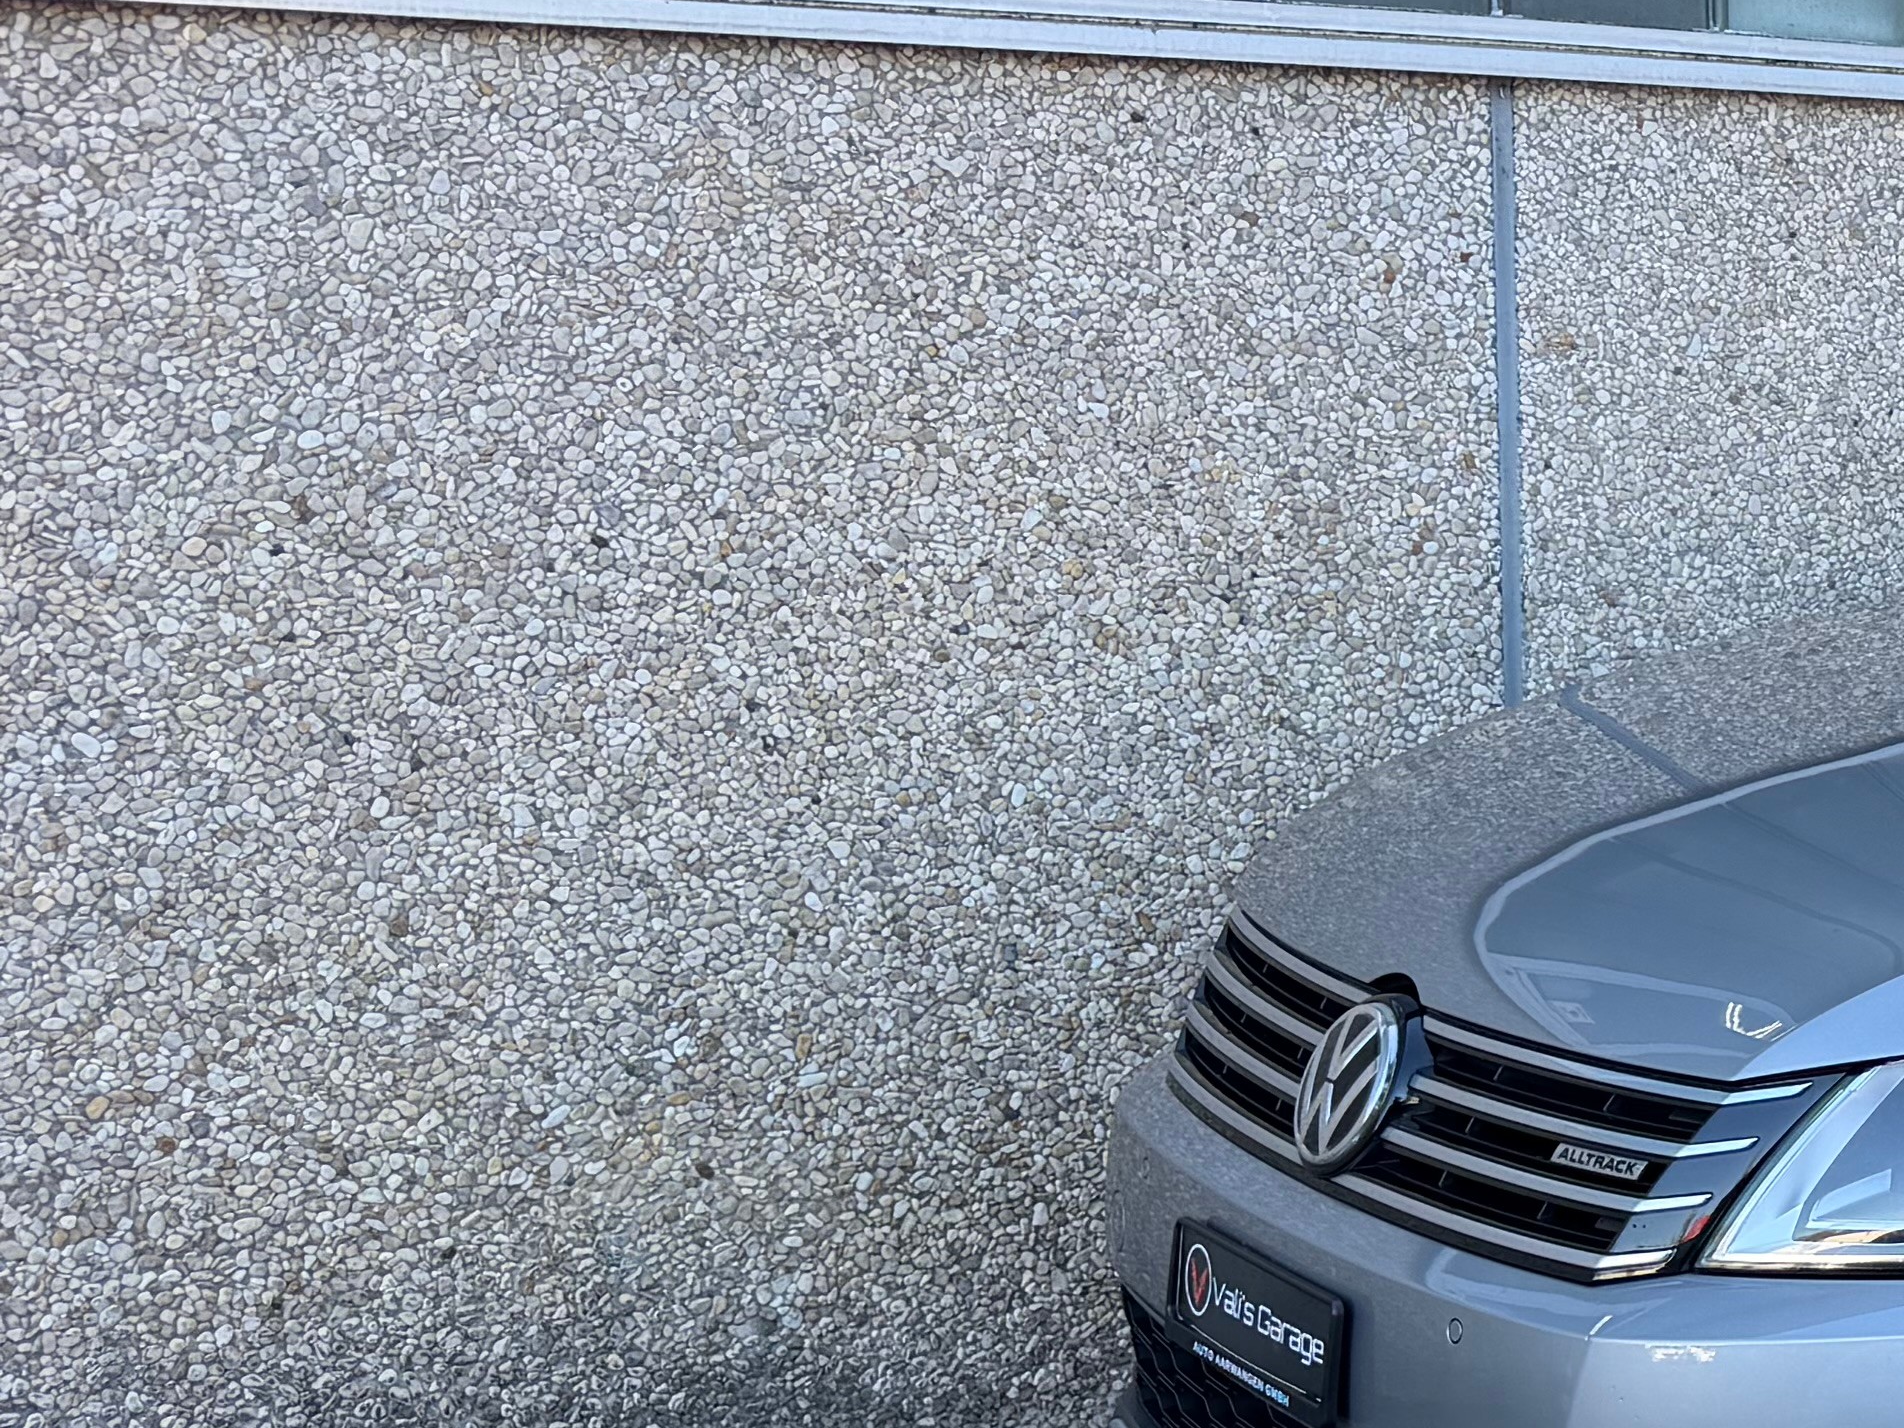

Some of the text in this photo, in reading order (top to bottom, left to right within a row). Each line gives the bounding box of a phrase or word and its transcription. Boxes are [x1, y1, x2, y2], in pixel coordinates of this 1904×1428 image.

[1557, 1147, 1638, 1176] ALLTRACK
[1212, 1276, 1325, 1366] Vali's Garage
